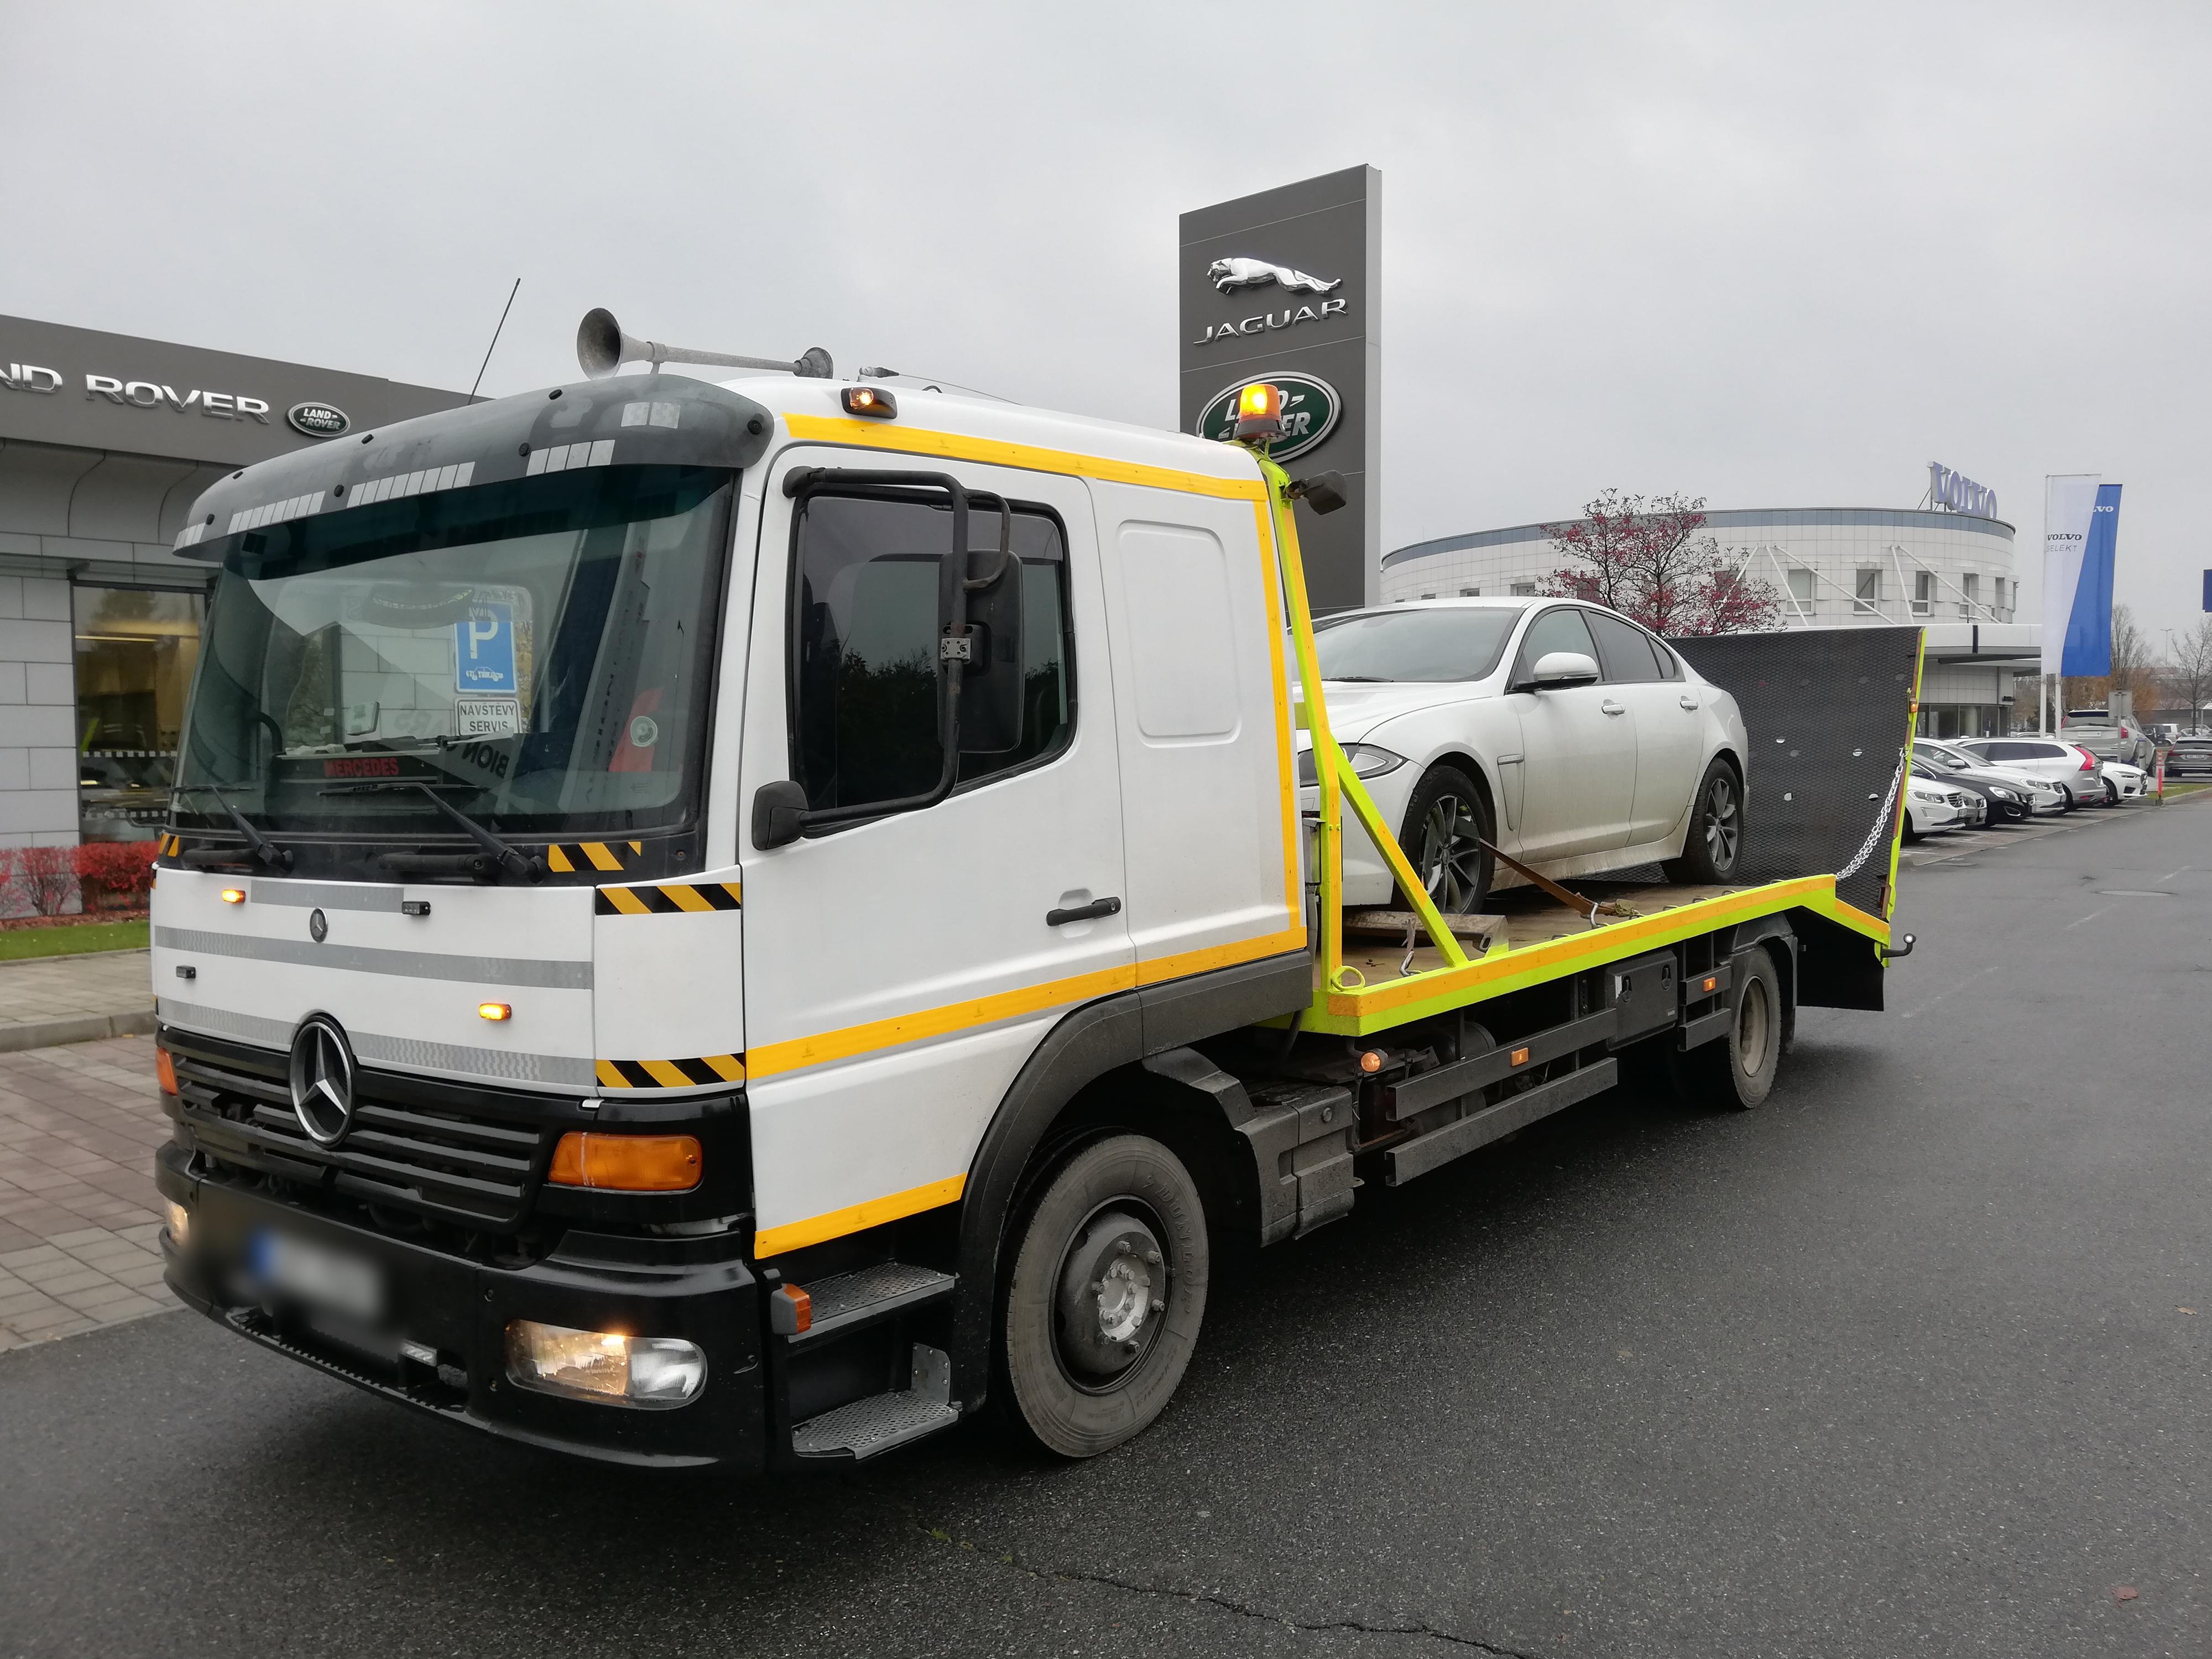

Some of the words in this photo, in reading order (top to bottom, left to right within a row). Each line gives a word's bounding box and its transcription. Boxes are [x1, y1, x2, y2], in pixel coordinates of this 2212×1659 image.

[1193, 298, 1348, 345] JAGUAR
[86, 374, 269, 424] ROVER
[305, 418, 341, 430] ROVER
[1928, 461, 1997, 519] VOLVO
[469, 608, 498, 659] P
[460, 702, 515, 716] NÁVŠTĚVY
[324, 757, 399, 778] MERCEDES
[1155, 1182, 1194, 1313] DUNLOP
